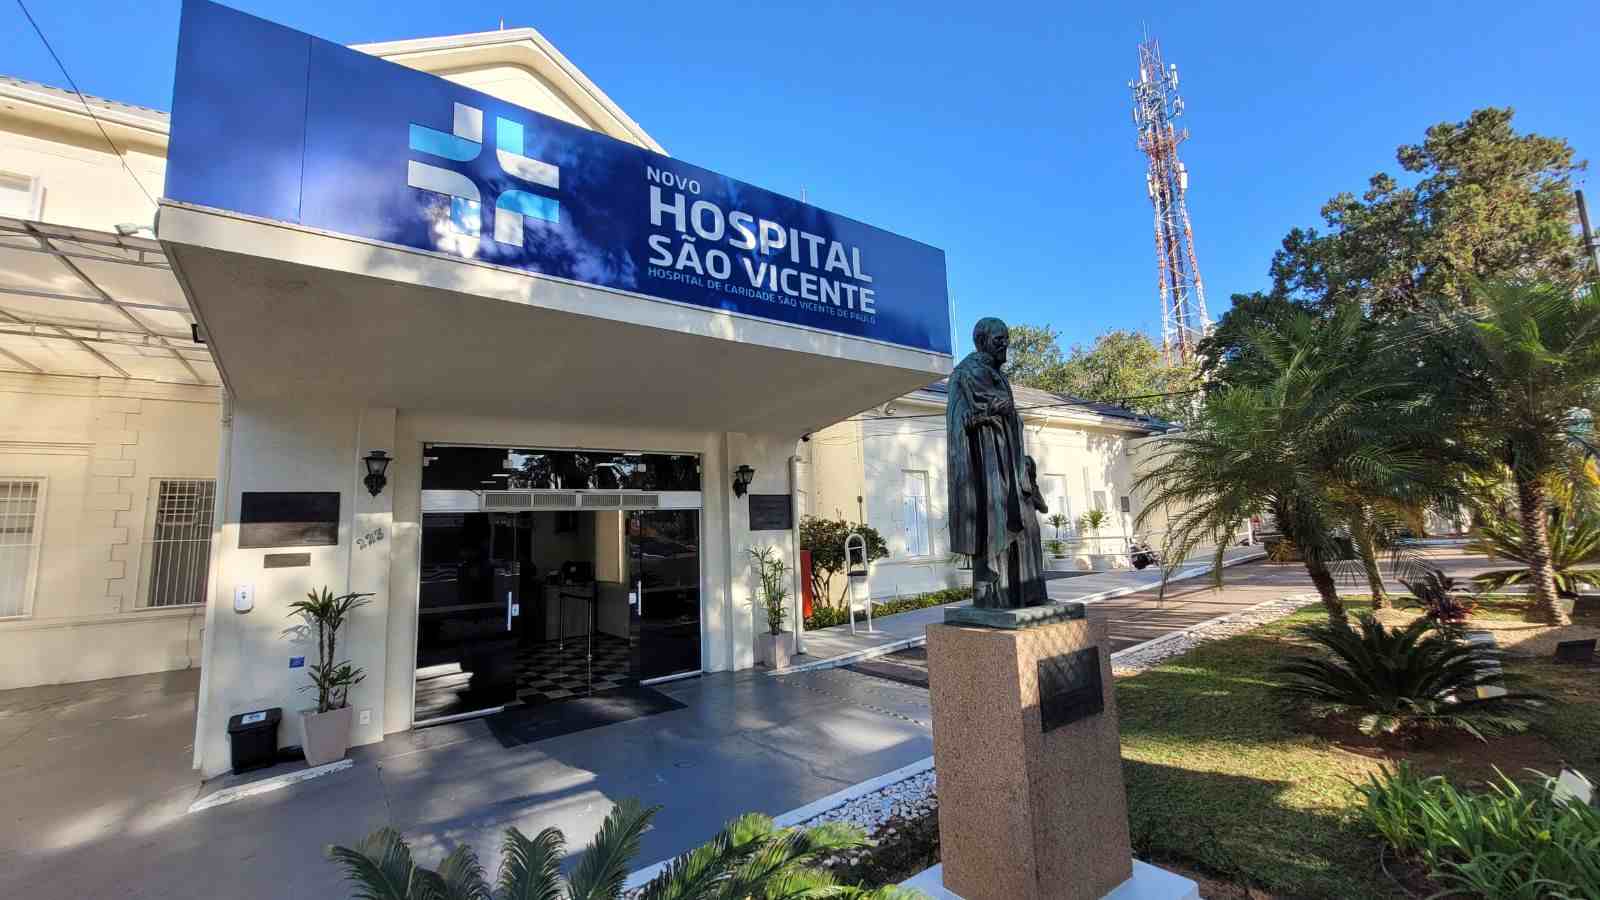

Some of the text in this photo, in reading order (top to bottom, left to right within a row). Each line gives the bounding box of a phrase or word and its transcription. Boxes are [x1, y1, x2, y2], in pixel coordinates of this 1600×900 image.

[647, 166, 700, 195] NOVO
[650, 185, 873, 283] HOSPITAL
[647, 266, 704, 288] HOSPITAL
[707, 279, 721, 291] DE
[724, 283, 776, 304] CARIDADE
[800, 301, 835, 317] VICENTE
[648, 234, 876, 314] SÃO VICENTE
